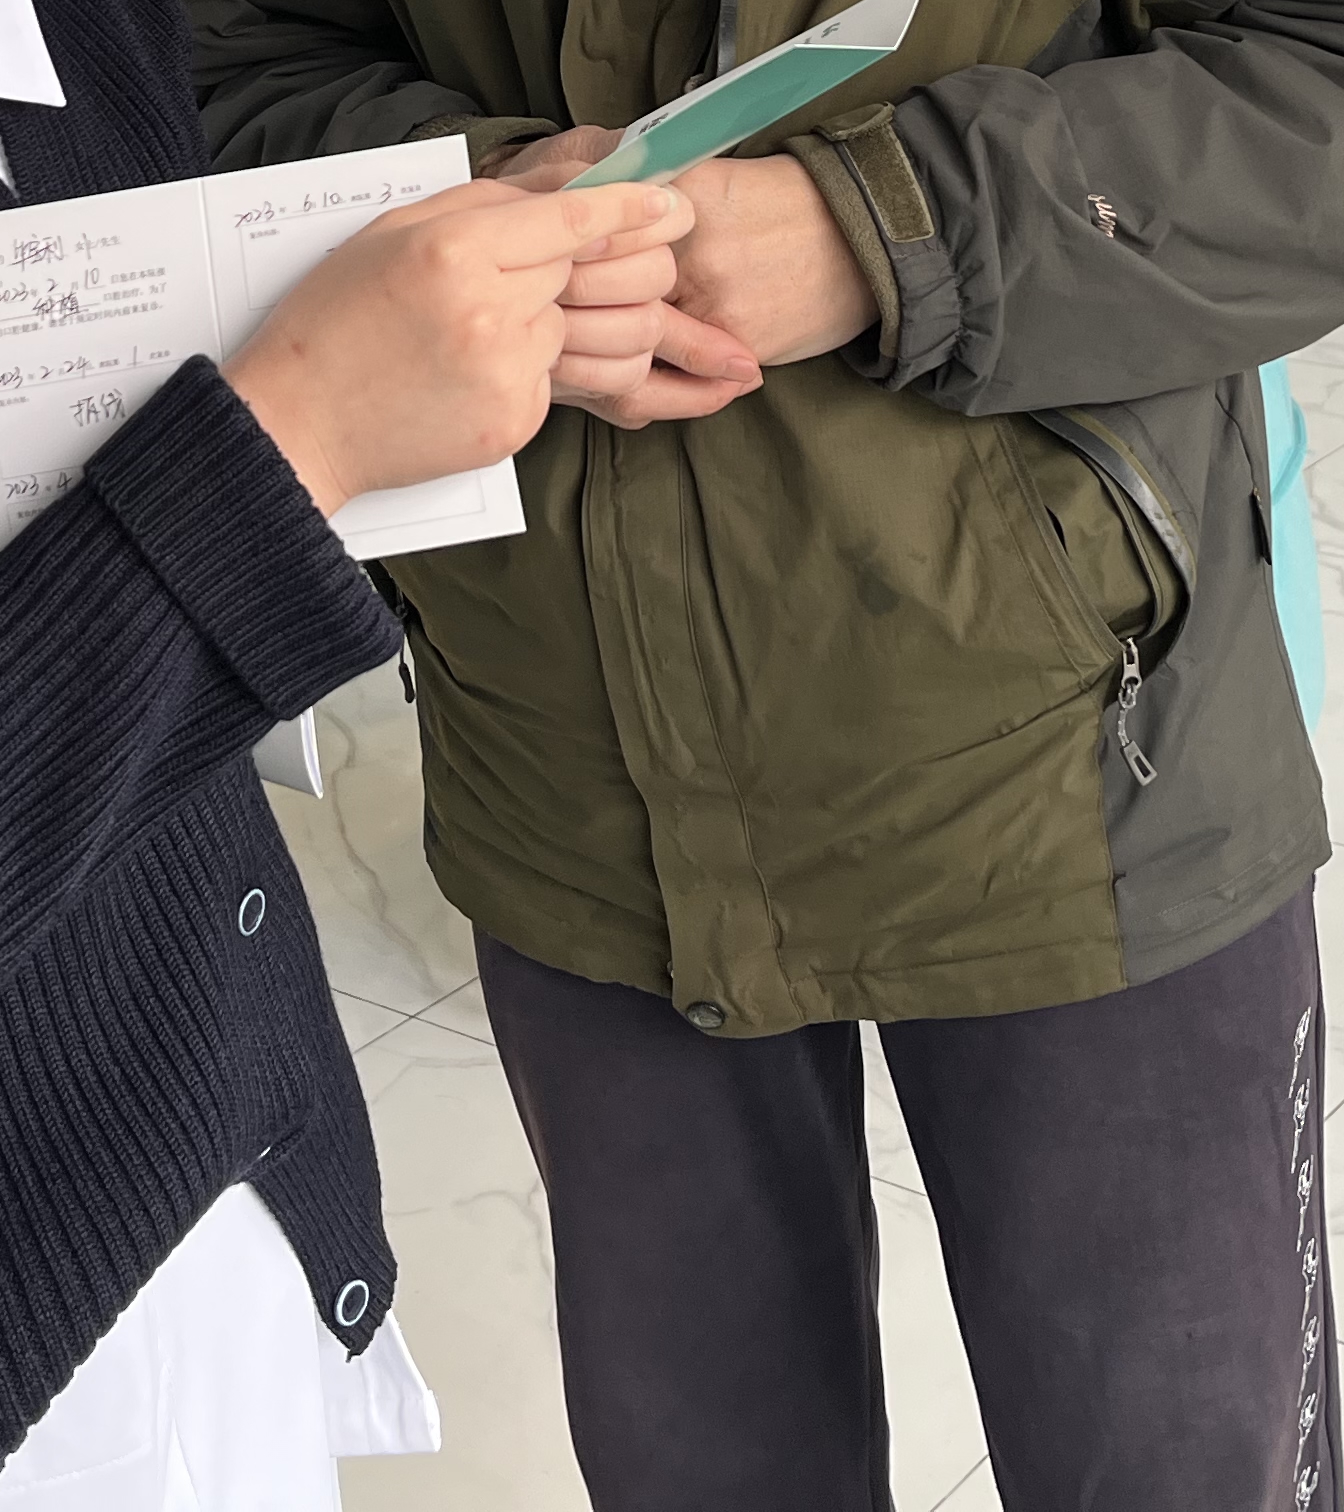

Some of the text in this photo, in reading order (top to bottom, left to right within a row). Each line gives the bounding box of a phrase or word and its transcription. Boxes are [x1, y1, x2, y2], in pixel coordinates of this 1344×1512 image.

[380, 182, 393, 205] 3
[47, 278, 58, 293] 2
[84, 267, 101, 289] 10
[40, 365, 55, 379] 2
[5, 474, 40, 499] 2023
